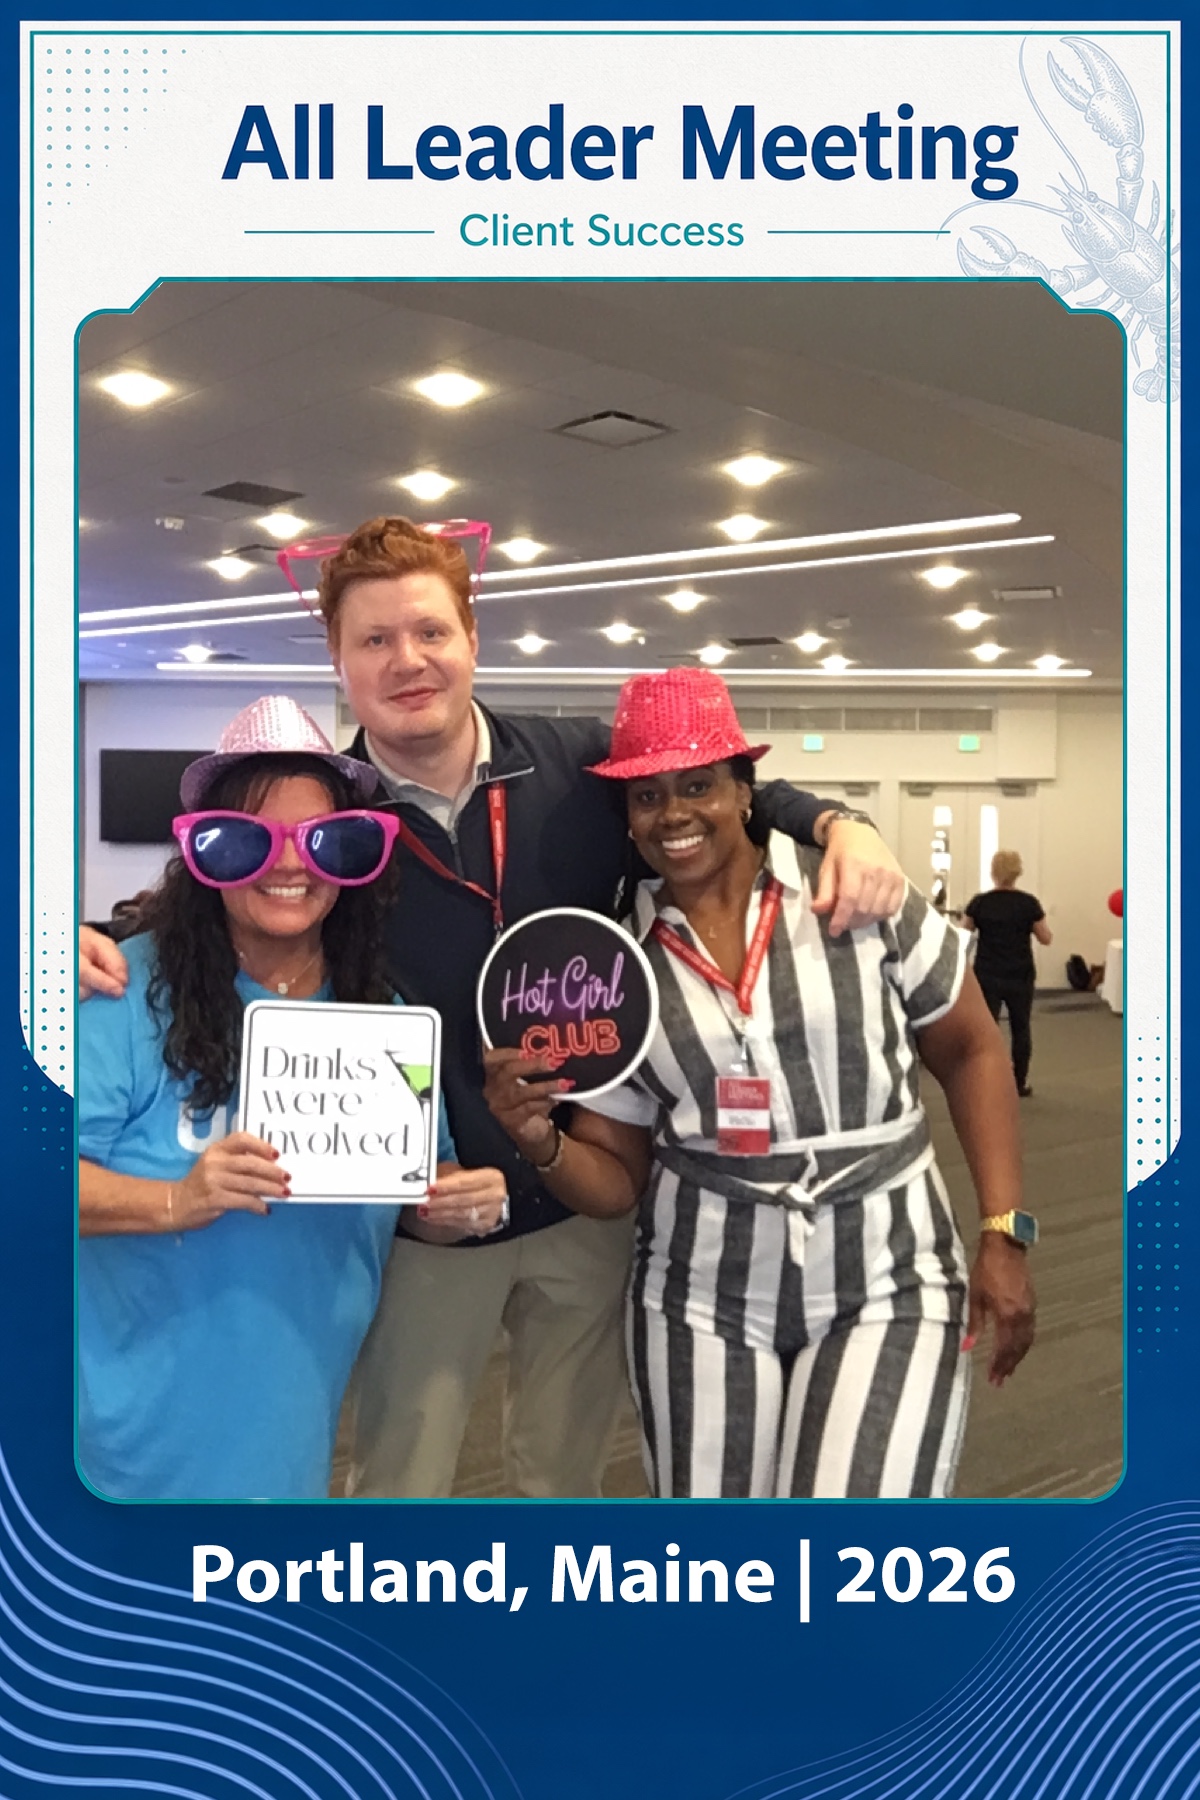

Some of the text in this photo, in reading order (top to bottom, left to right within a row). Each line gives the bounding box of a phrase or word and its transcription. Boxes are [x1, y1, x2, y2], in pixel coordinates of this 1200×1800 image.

[502, 962, 556, 1021] Hot
[561, 951, 625, 1021] Girl
[521, 1019, 621, 1058] CLUB
[262, 1046, 377, 1080] Drinks
[262, 1090, 363, 1115] were
[259, 1122, 408, 1156] Involved
